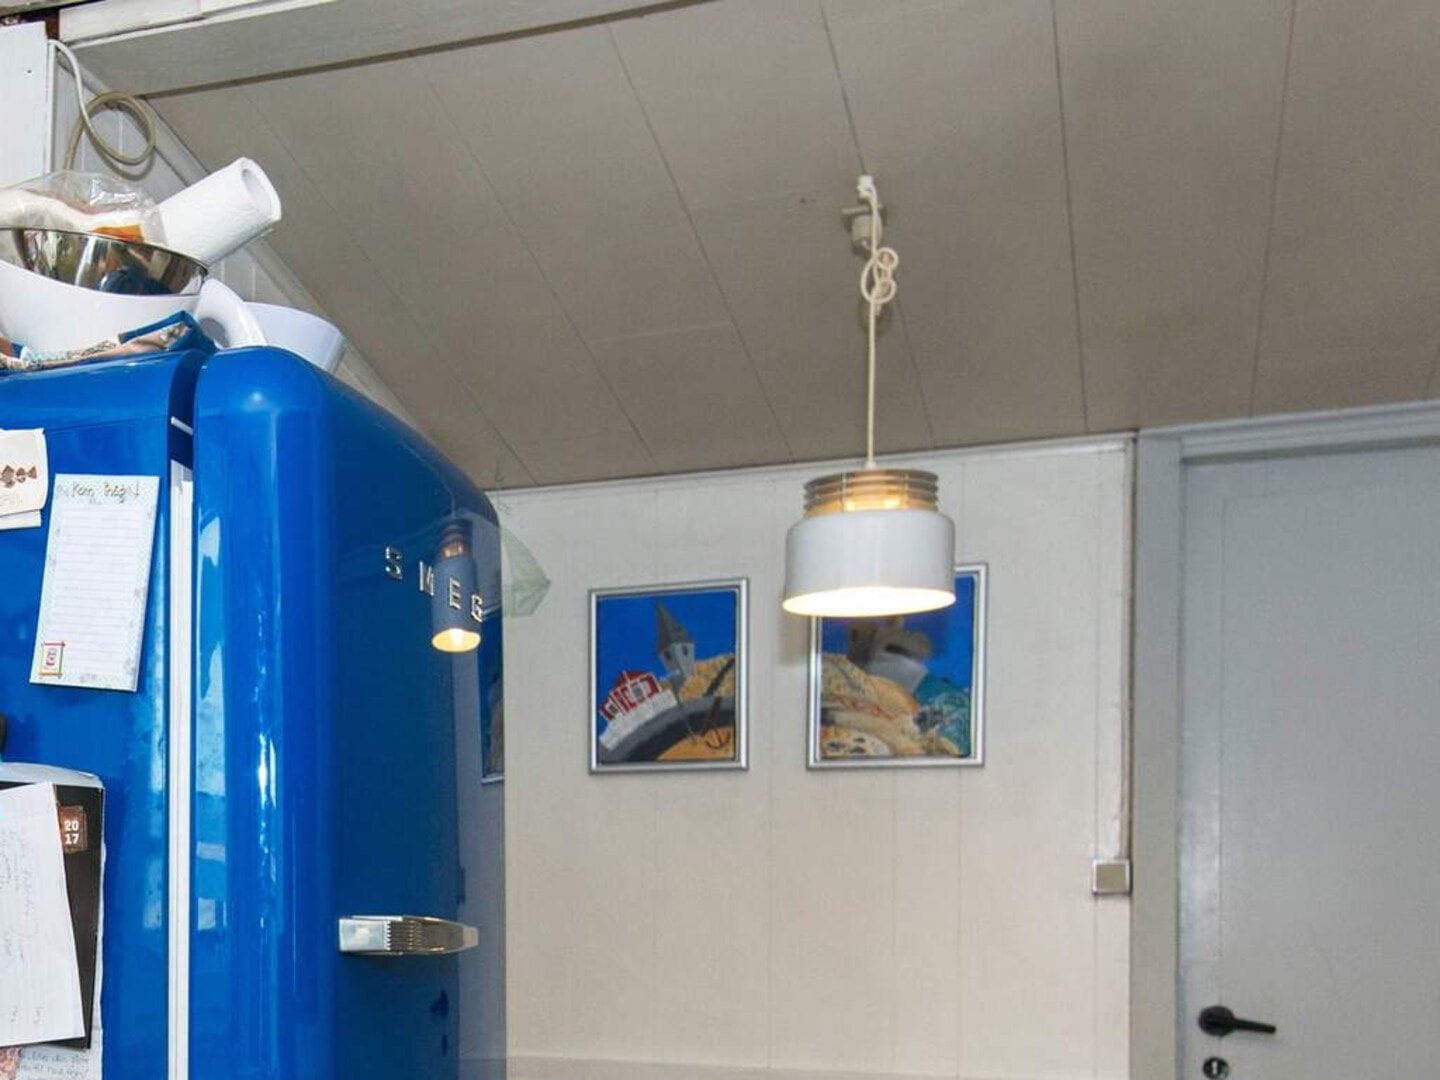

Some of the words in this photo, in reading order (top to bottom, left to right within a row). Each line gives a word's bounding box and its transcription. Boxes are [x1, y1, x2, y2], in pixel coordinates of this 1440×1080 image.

[385, 545, 483, 622] SMEG
[64, 820, 79, 831] 20
[65, 833, 79, 844] 17
